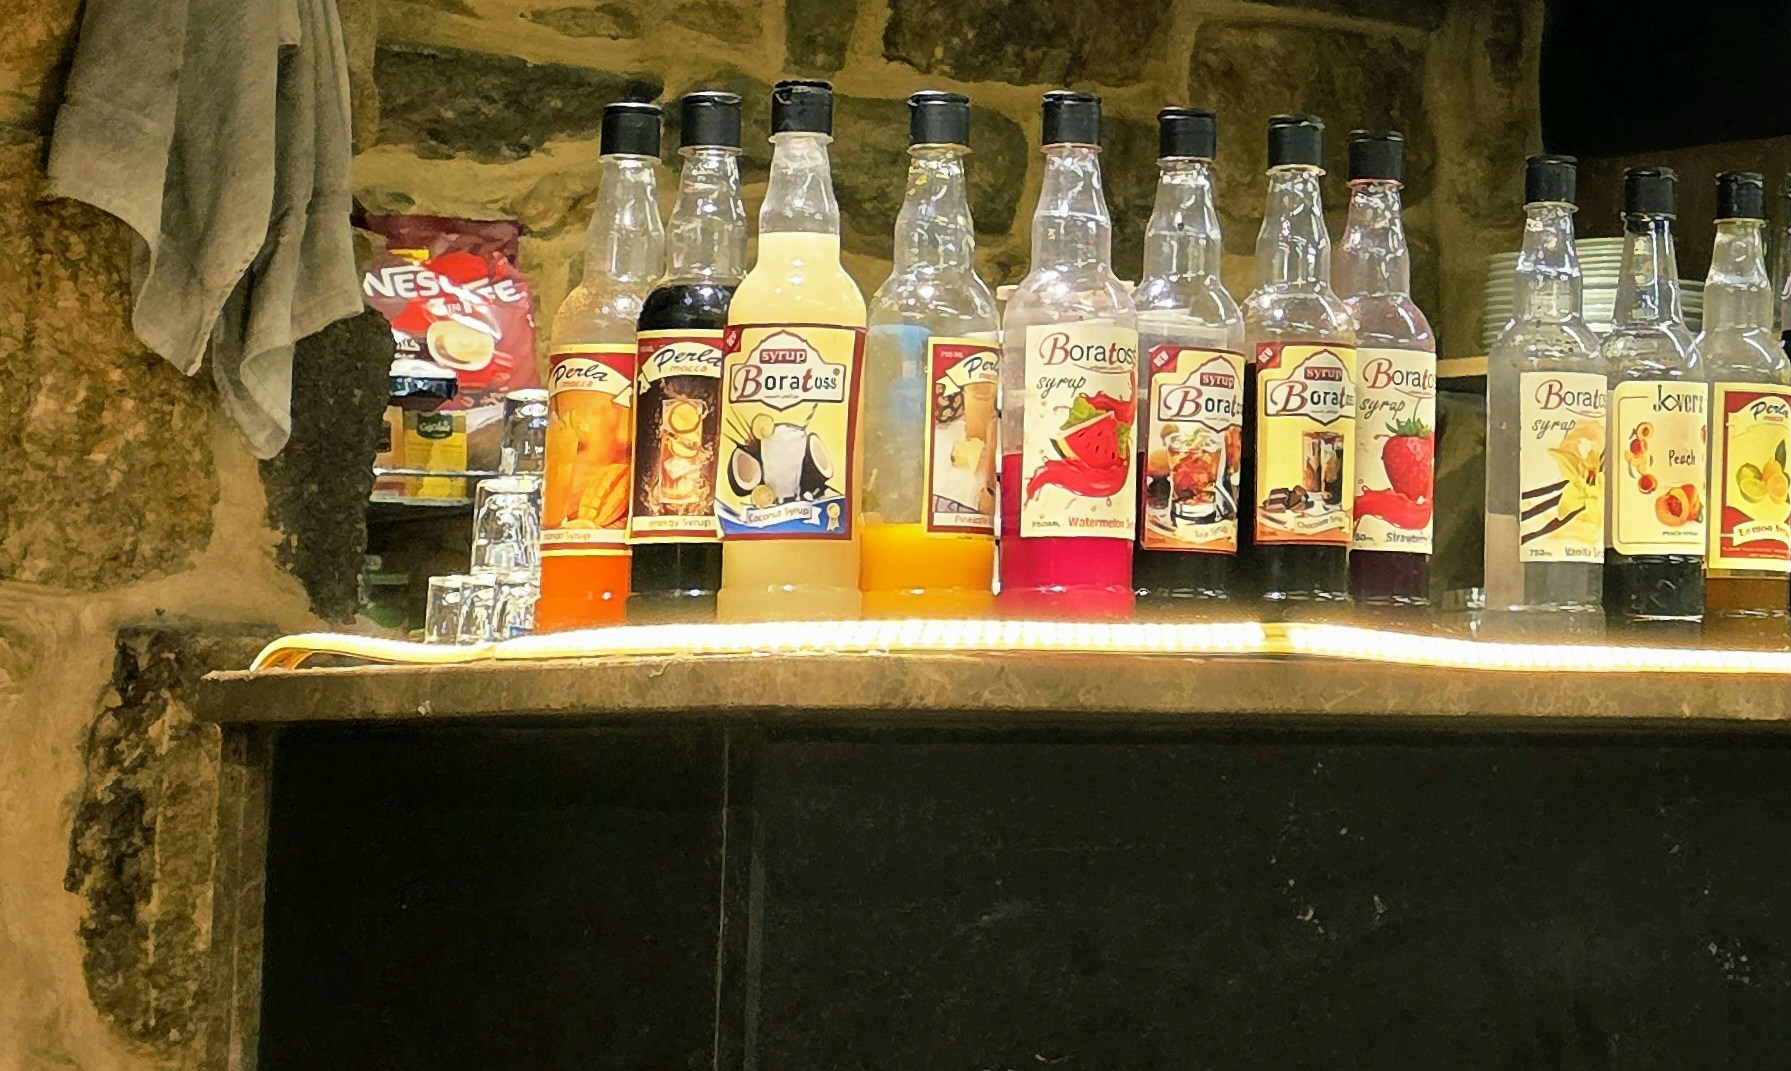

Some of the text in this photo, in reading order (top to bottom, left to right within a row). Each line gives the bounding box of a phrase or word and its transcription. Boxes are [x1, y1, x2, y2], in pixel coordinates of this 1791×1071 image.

[653, 348, 723, 374] Perla
[761, 350, 806, 363] syrup
[553, 364, 608, 389] Perla
[1202, 374, 1235, 388] syrup
[1306, 368, 1341, 380] syrup
[1037, 376, 1087, 399] syrup
[1359, 398, 1405, 419] syrup
[1532, 419, 1576, 439] syrup
[1668, 449, 1696, 467] Peach
[1069, 517, 1125, 528] Watermelon
